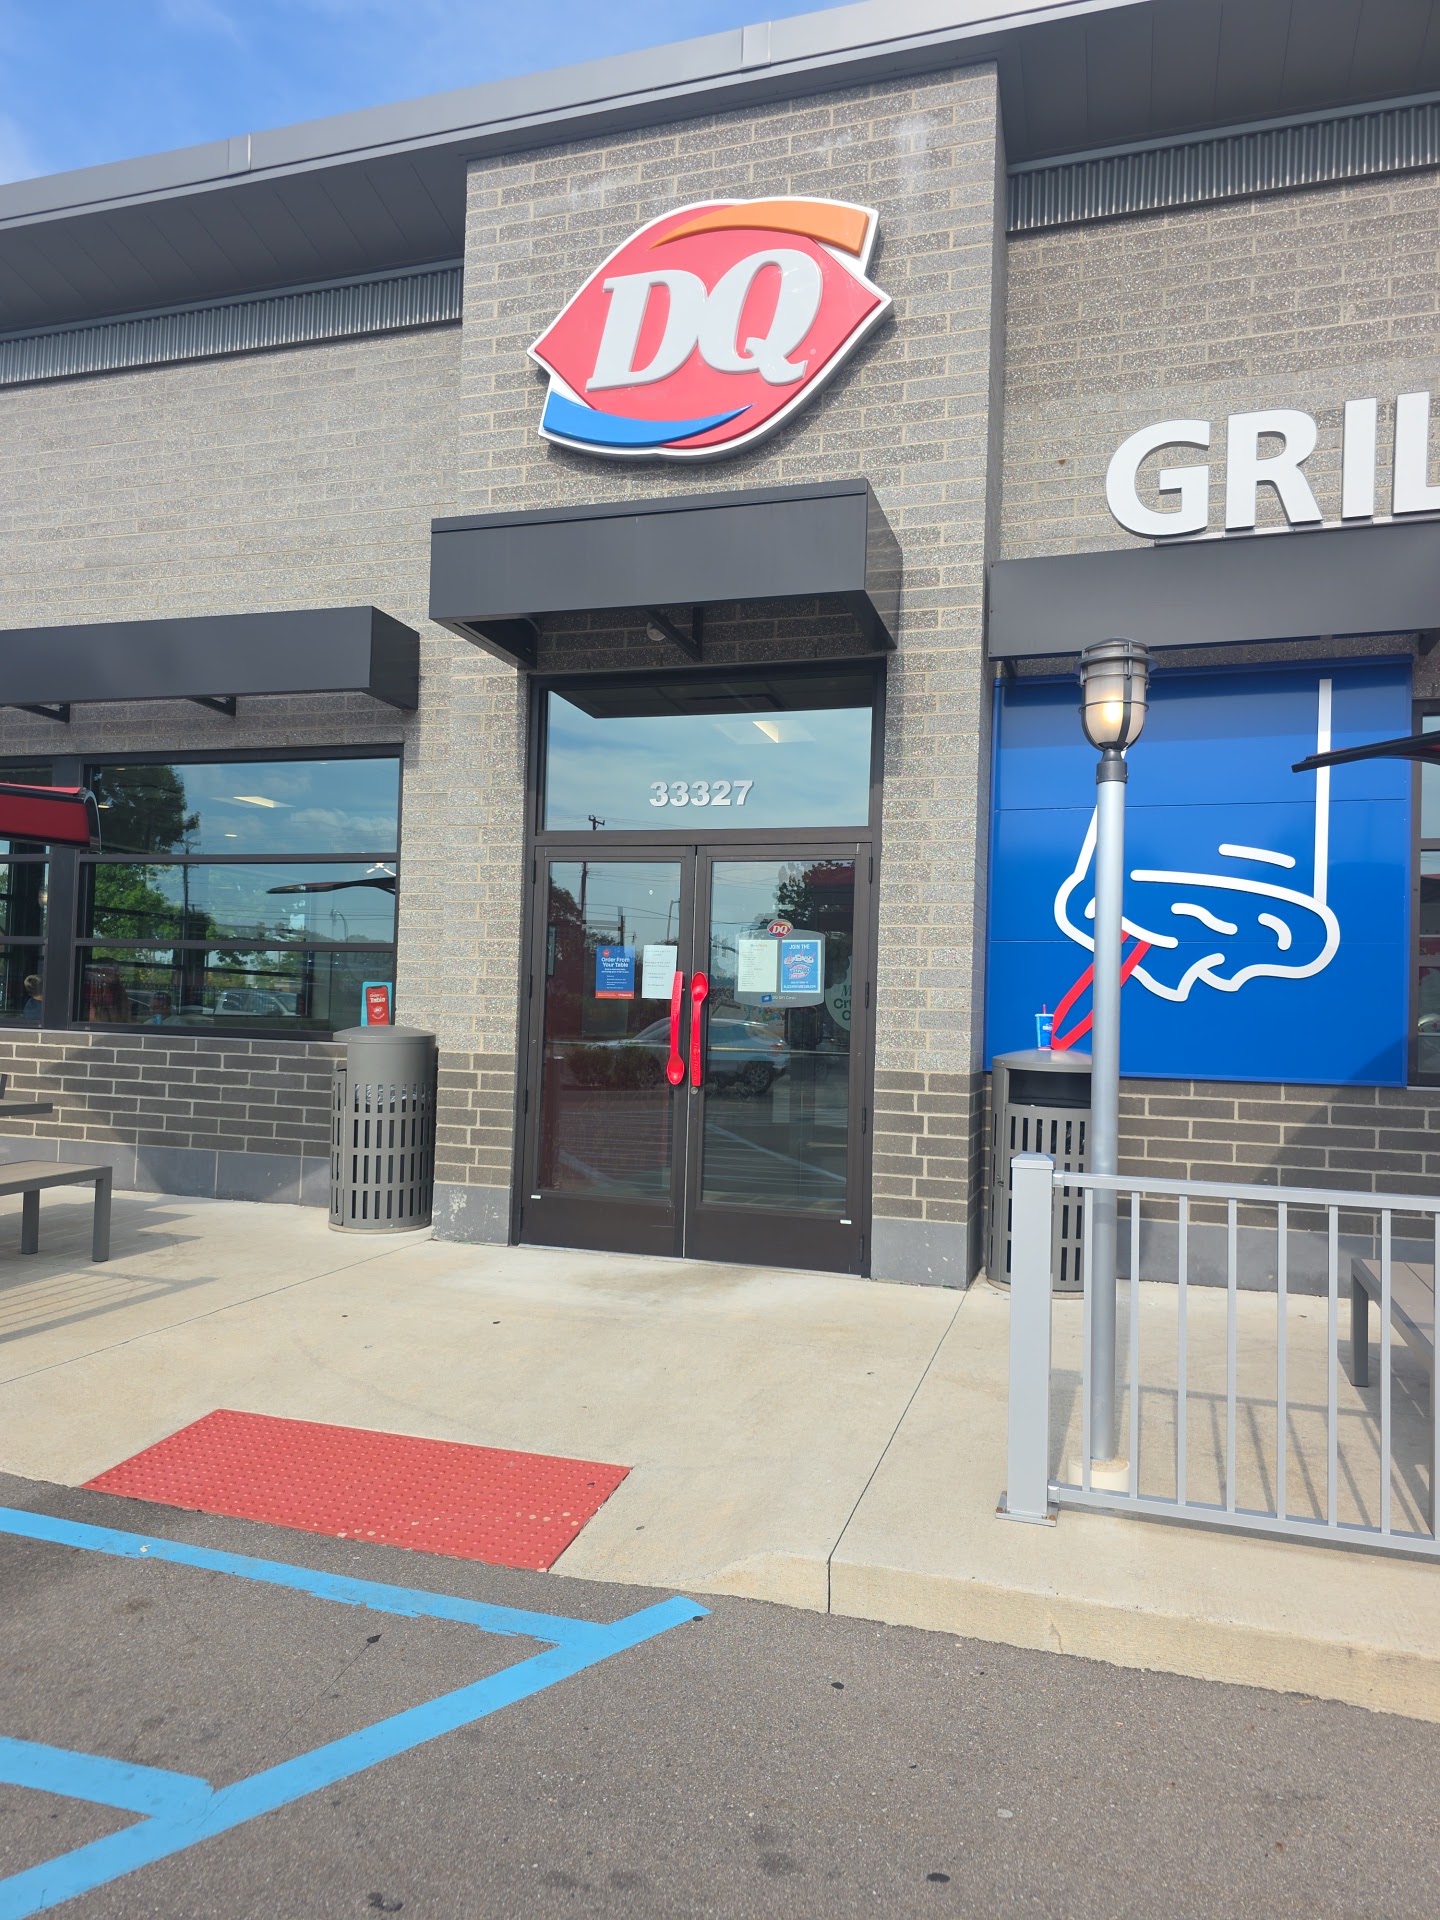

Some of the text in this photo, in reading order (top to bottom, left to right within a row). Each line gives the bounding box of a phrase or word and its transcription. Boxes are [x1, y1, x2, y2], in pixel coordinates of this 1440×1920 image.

[585, 248, 823, 387] DQ
[649, 780, 754, 807] 33327
[772, 925, 788, 935] DQ
